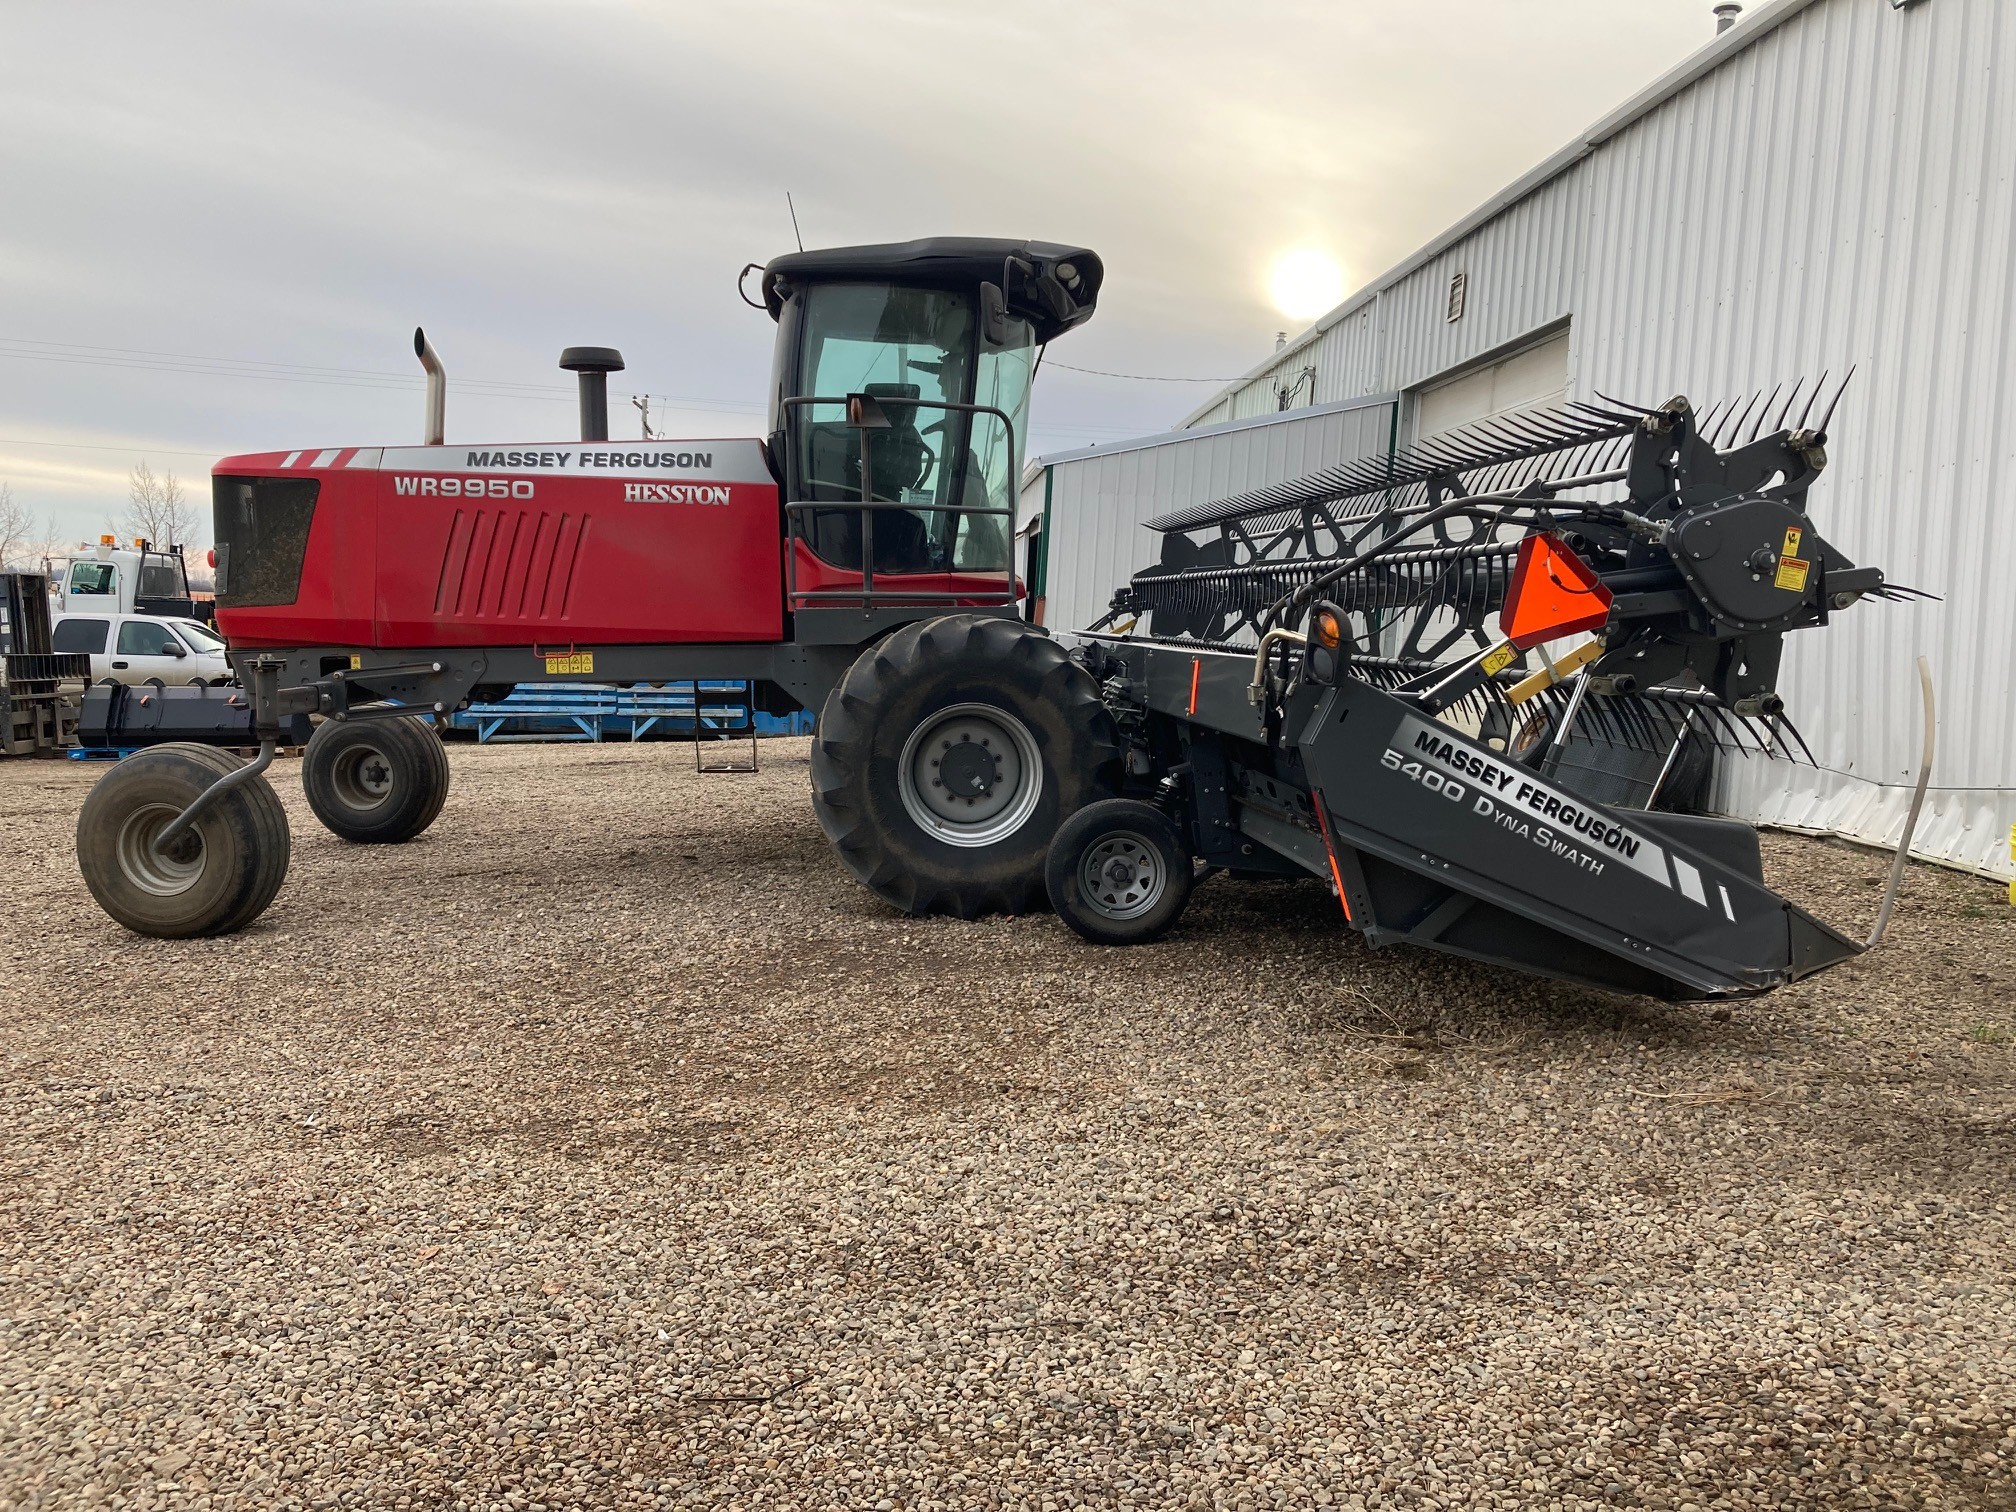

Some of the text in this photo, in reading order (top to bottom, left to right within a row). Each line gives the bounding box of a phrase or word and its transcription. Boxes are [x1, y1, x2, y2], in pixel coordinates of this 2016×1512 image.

[466, 451, 712, 469] MASSEY FERGUSON
[394, 477, 535, 500] WR9950
[624, 483, 731, 505] HESSTON
[1381, 749, 1465, 802] 5400
[1415, 730, 1640, 859] MASSEY FERGUSON
